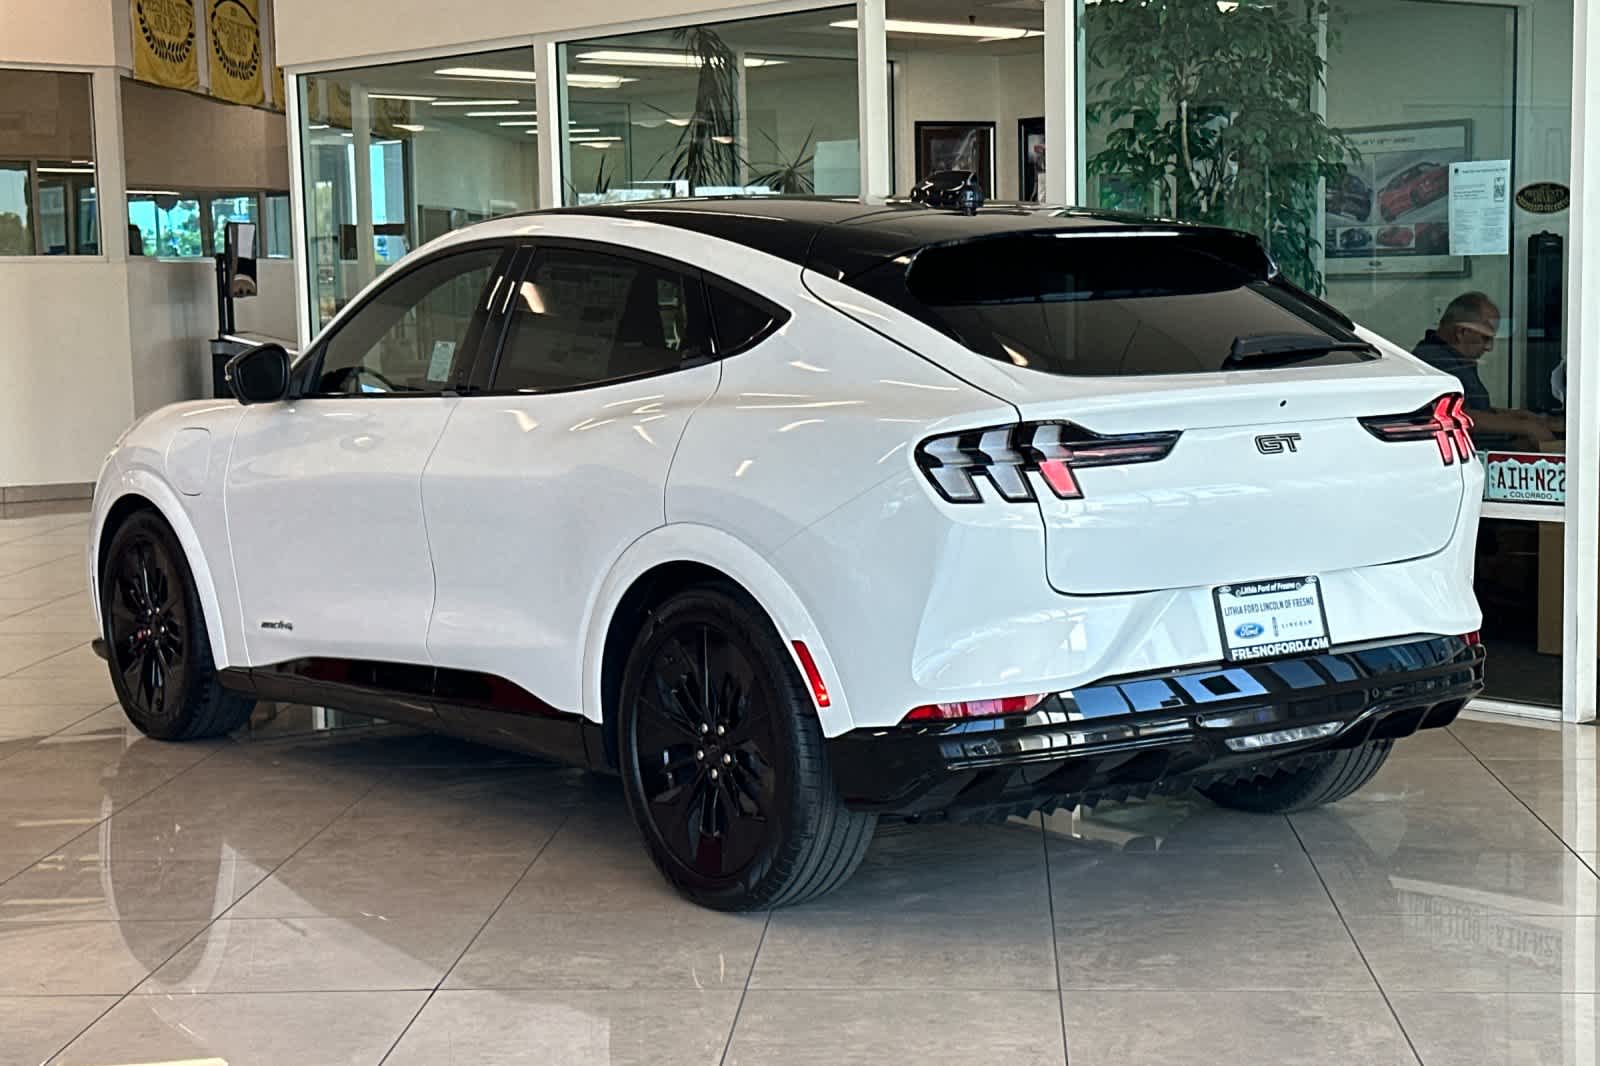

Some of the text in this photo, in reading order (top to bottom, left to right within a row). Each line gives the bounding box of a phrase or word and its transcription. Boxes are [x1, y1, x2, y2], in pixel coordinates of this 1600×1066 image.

[1255, 433, 1301, 455] GT
[1510, 491, 1553, 500] COLORADO
[1240, 586, 1257, 594] Lithia
[1257, 584, 1271, 592] Ford
[1224, 597, 1314, 616] LITHIA FORD LINCOLN OF FRESNO
[1281, 620, 1313, 629] LINCOLN
[1240, 625, 1259, 637] Ford
[1232, 637, 1329, 661] FRESNOFORD.COM
